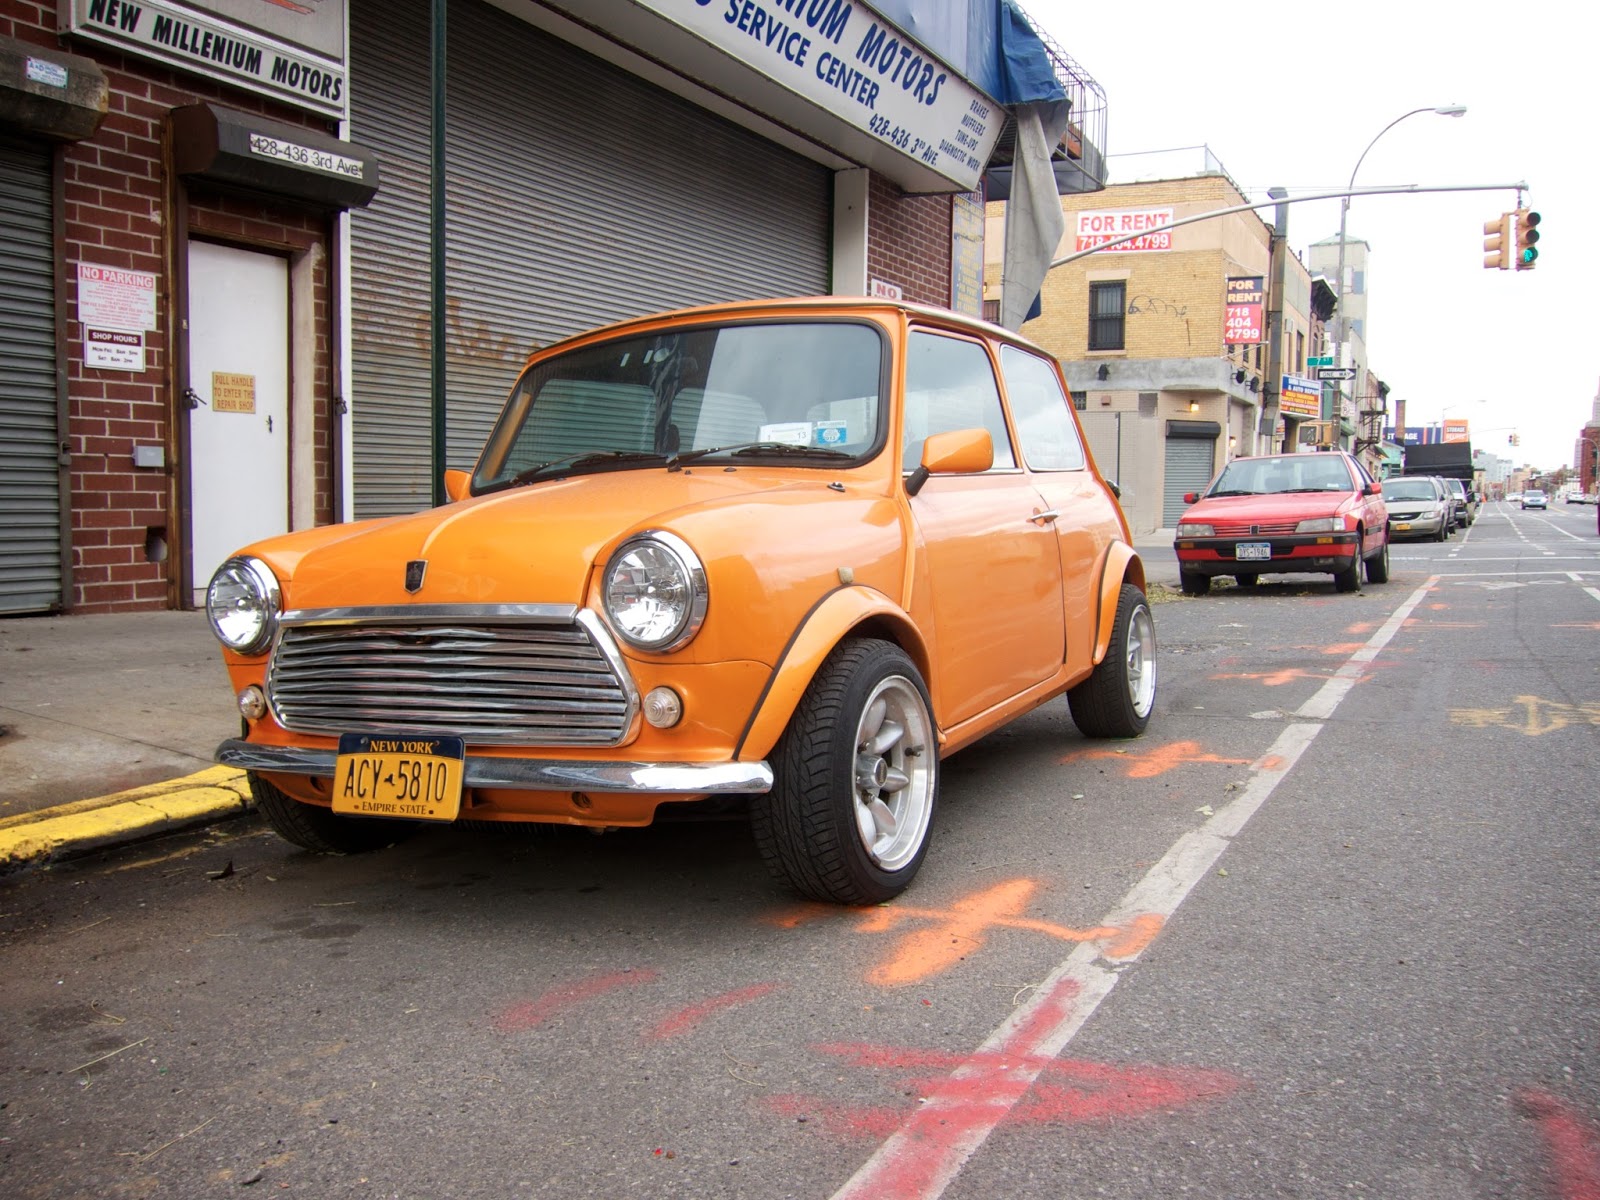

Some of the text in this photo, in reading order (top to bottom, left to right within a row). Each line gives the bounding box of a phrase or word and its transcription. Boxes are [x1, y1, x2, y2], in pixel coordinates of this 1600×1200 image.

[89, 0, 343, 101] NEW MILLENIUM MOTORS
[724, 0, 880, 110] SERVICE CENTER
[856, 22, 947, 106] MOTORS
[970, 99, 989, 120] BRAKES
[869, 113, 911, 149] 428-436
[961, 113, 986, 136] MUFFLERS
[955, 129, 978, 151] TUNE-UPS
[253, 137, 309, 163] 428-436
[312, 152, 333, 169] 3rd
[939, 139, 981, 173] DIAGNOSTIC WORK
[1081, 214, 1169, 232] FOR RENT
[82, 266, 99, 280] NO
[102, 269, 153, 288] PARKING
[1228, 280, 1254, 290] FOR
[876, 283, 897, 299] NO
[1227, 292, 1262, 303] RENT
[1227, 307, 1250, 317] 718
[1226, 317, 1251, 328] 404
[92, 331, 138, 344] SHOP HOURS
[1225, 328, 1260, 339] 4799
[215, 375, 254, 387] PULL HANDLE
[214, 387, 254, 400] TO ENTER THE
[217, 399, 254, 411] REPAIR SHOP
[370, 740, 434, 754] NEW YORK
[361, 801, 427, 815] EMPIRE STATE
